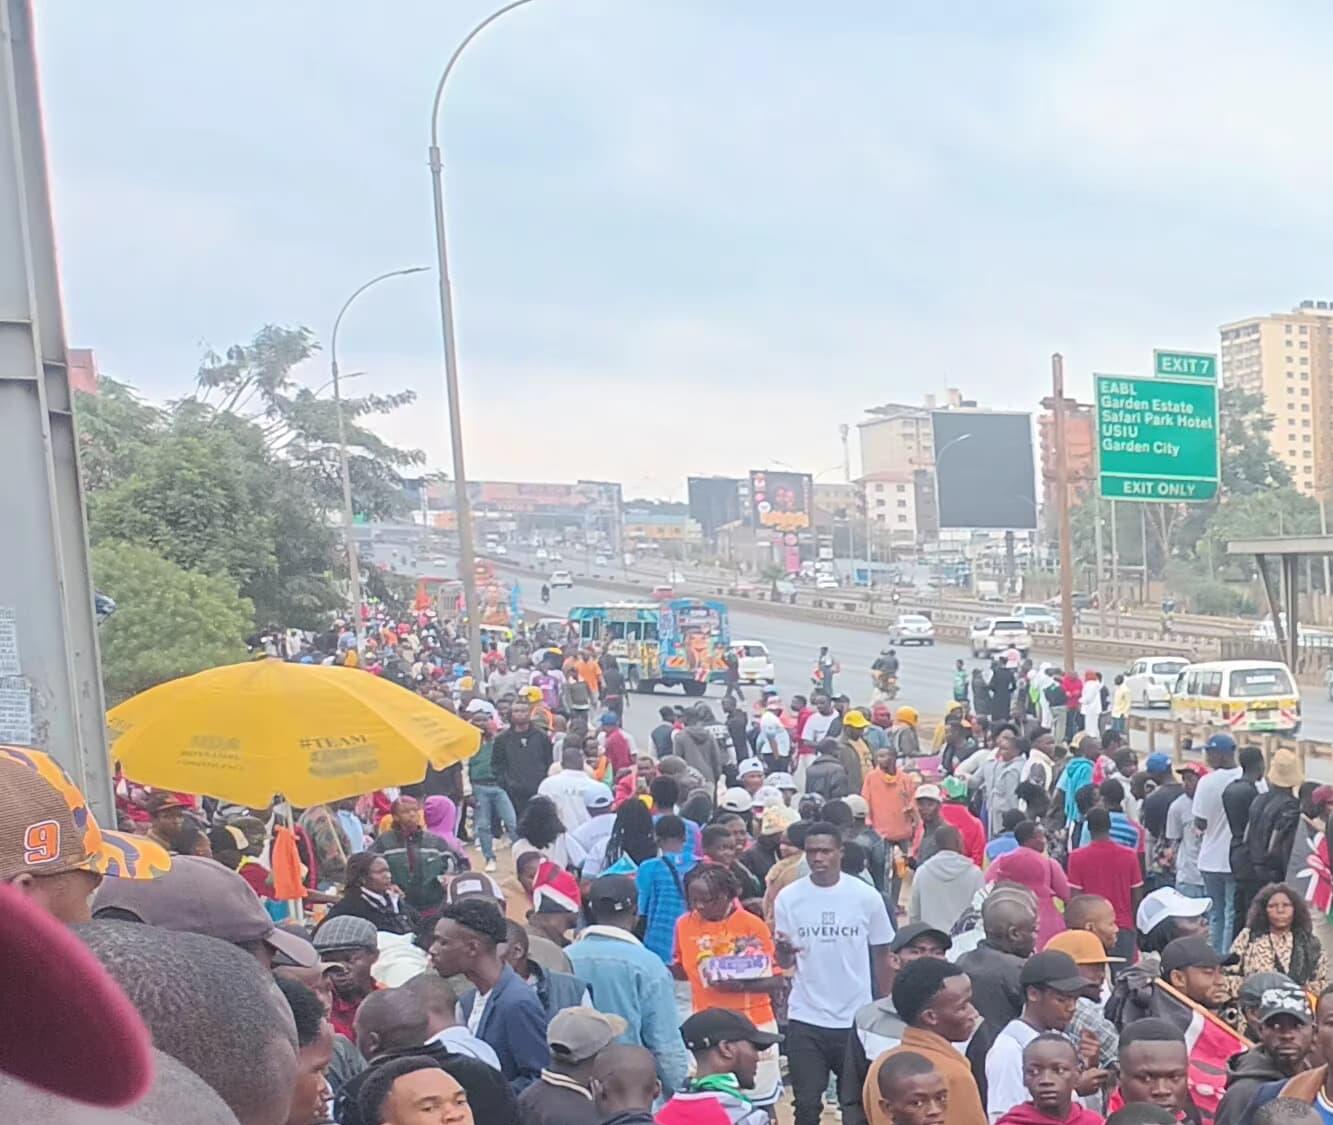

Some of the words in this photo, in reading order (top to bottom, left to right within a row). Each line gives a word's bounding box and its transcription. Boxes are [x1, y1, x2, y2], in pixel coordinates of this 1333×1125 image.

[1161, 357, 1195, 373] EXIT
[1201, 359, 1209, 373] 7
[1100, 381, 1137, 395] EABL
[1101, 396, 1149, 410] Garden
[1152, 400, 1194, 414] Estate
[1102, 411, 1141, 424] Safari
[1145, 413, 1174, 426] Park
[1177, 415, 1212, 429] Hotel
[1102, 426, 1138, 437] USIU
[1102, 440, 1150, 453] Garden
[1153, 442, 1180, 457] City
[1123, 482, 1153, 494] EXIT
[1157, 483, 1196, 496] ONLY
[24, 820, 61, 865] 9
